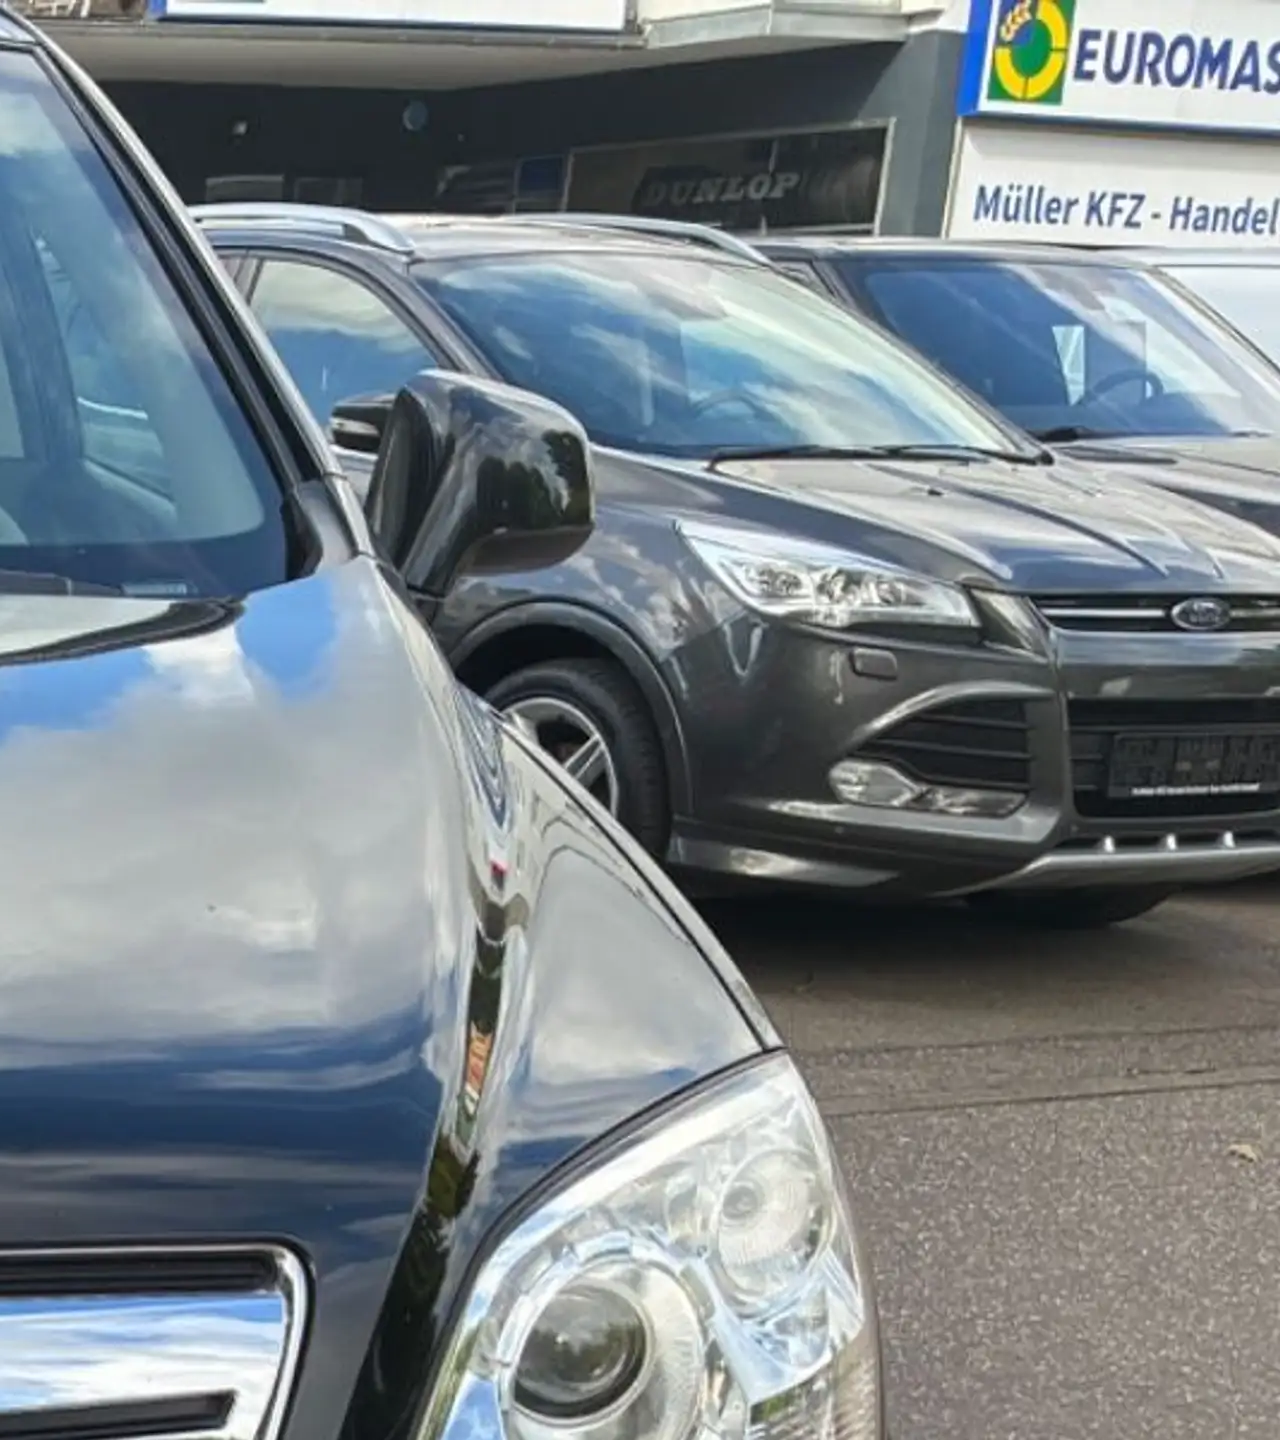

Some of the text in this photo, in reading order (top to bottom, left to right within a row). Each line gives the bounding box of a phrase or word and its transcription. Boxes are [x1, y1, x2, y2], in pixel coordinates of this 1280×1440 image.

[641, 172, 800, 207] DUNLOP
[973, 183, 1079, 226] Müller
[1085, 190, 1146, 230] KFZ
[1168, 196, 1280, 236] Handel
